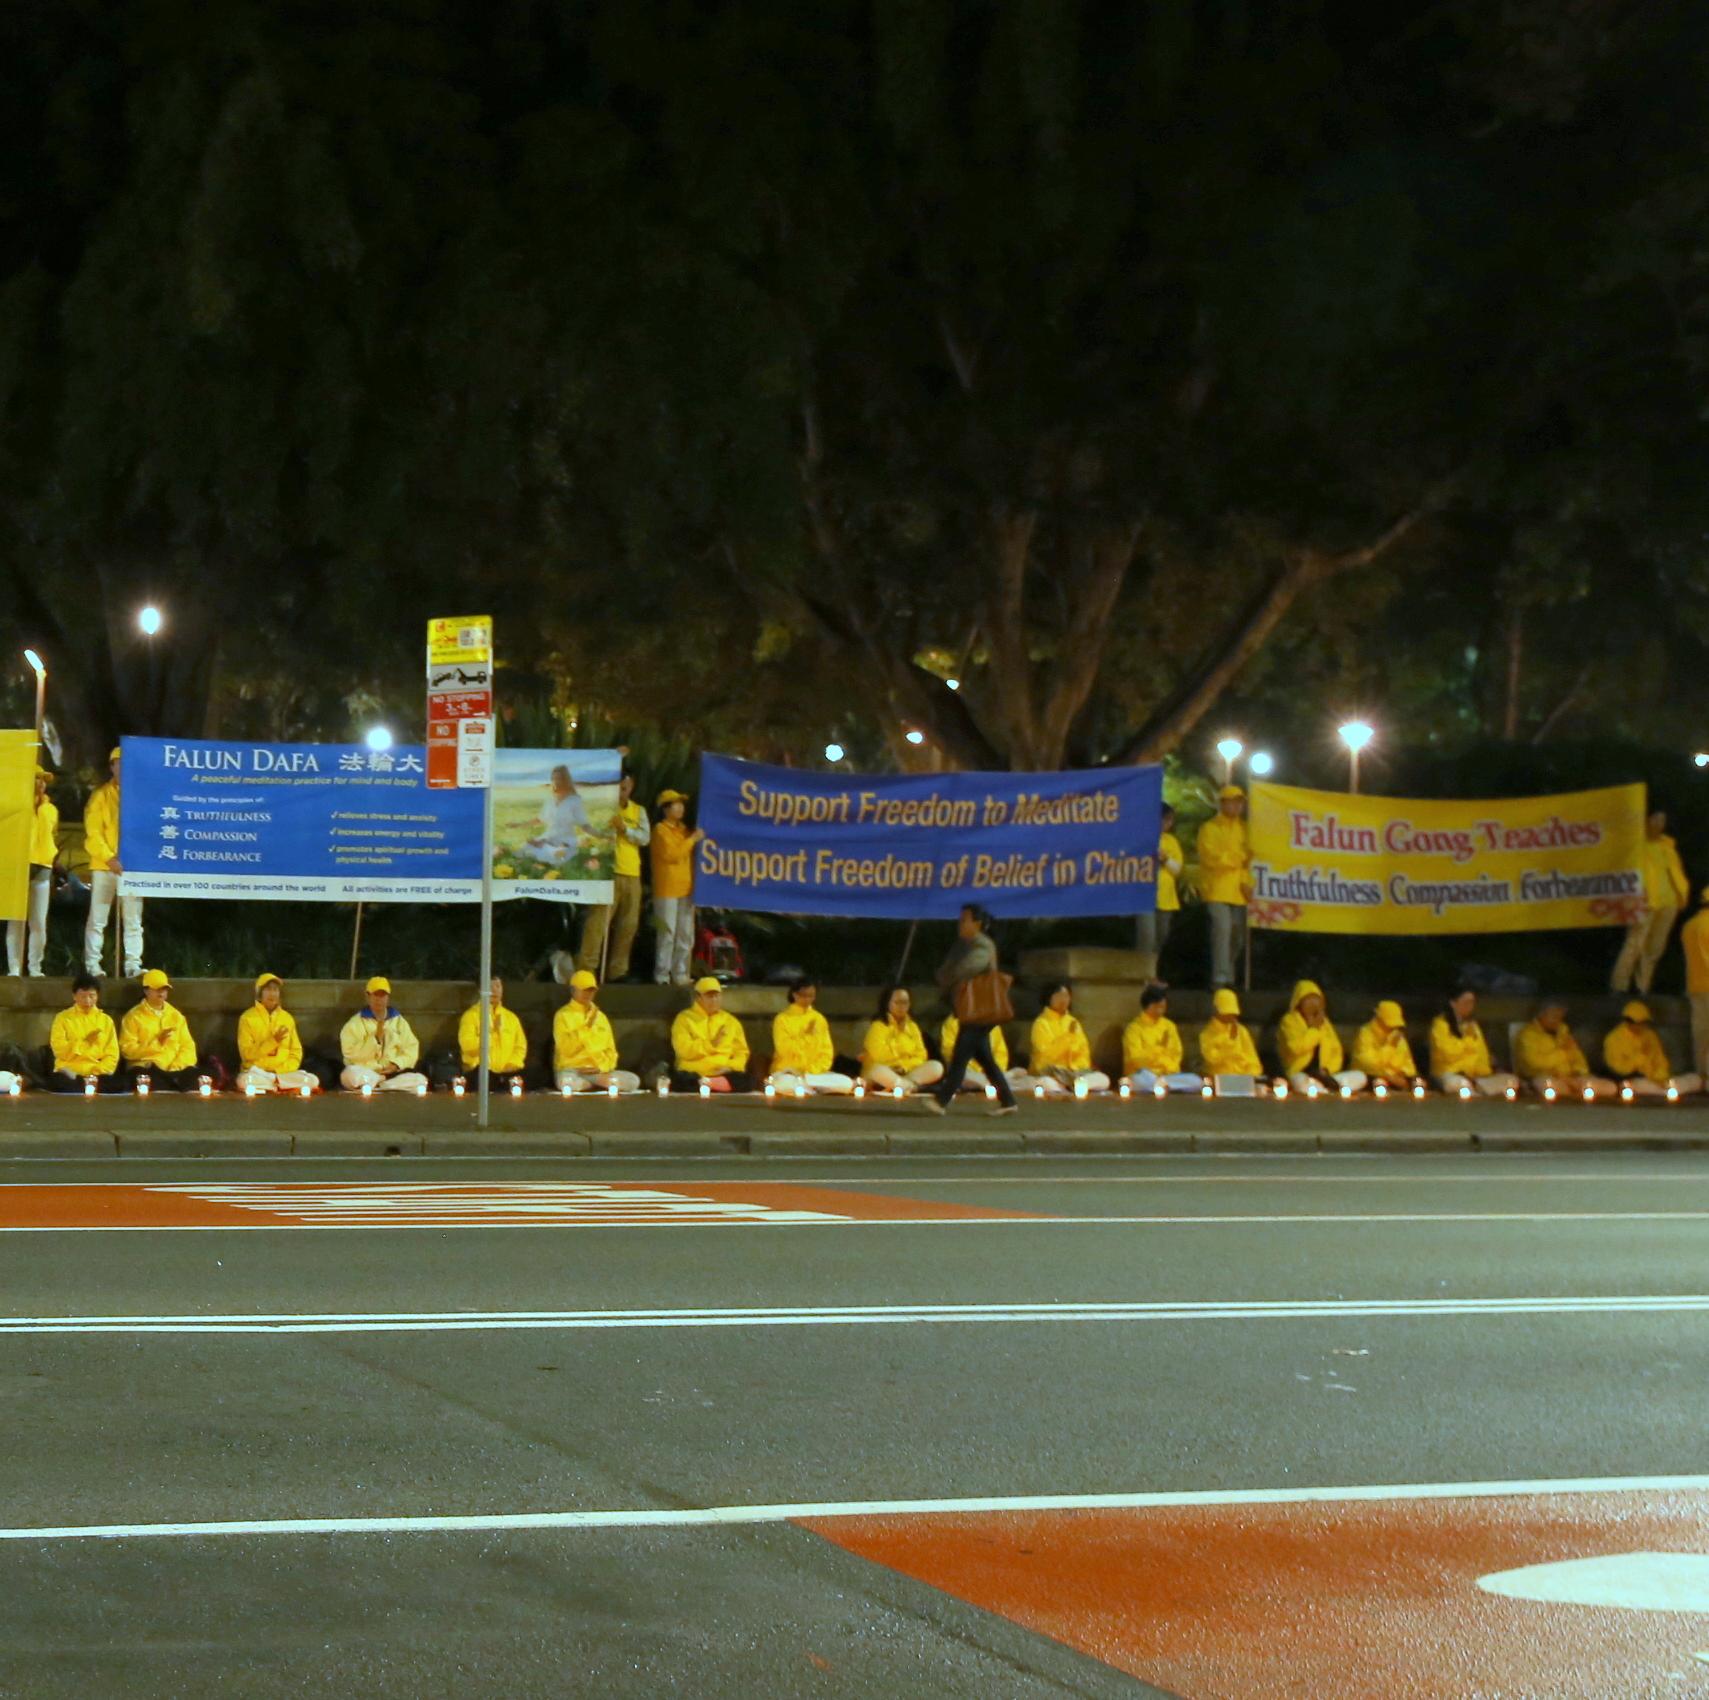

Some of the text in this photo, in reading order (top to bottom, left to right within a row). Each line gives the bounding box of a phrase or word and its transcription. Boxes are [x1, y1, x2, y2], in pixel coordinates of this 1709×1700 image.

[436, 725, 450, 736] NO
[242, 776, 292, 785] meditation
[739, 780, 1119, 827] Support Freedom to Meditate
[1291, 811, 1601, 862] Falun Gong Teaches
[701, 840, 1154, 888] Support Freedom of Belief in China
[124, 880, 161, 889] Practised
[194, 882, 209, 890] 100
[211, 883, 250, 891] countries
[253, 884, 283, 892] around
[286, 884, 299, 892] the
[342, 885, 353, 893] All
[356, 885, 392, 894] activities
[410, 886, 431, 894] FREE
[434, 886, 442, 894] of
[444, 886, 472, 895] charge
[1253, 865, 1381, 902] Truthfulness
[1391, 873, 1510, 914] Compassion
